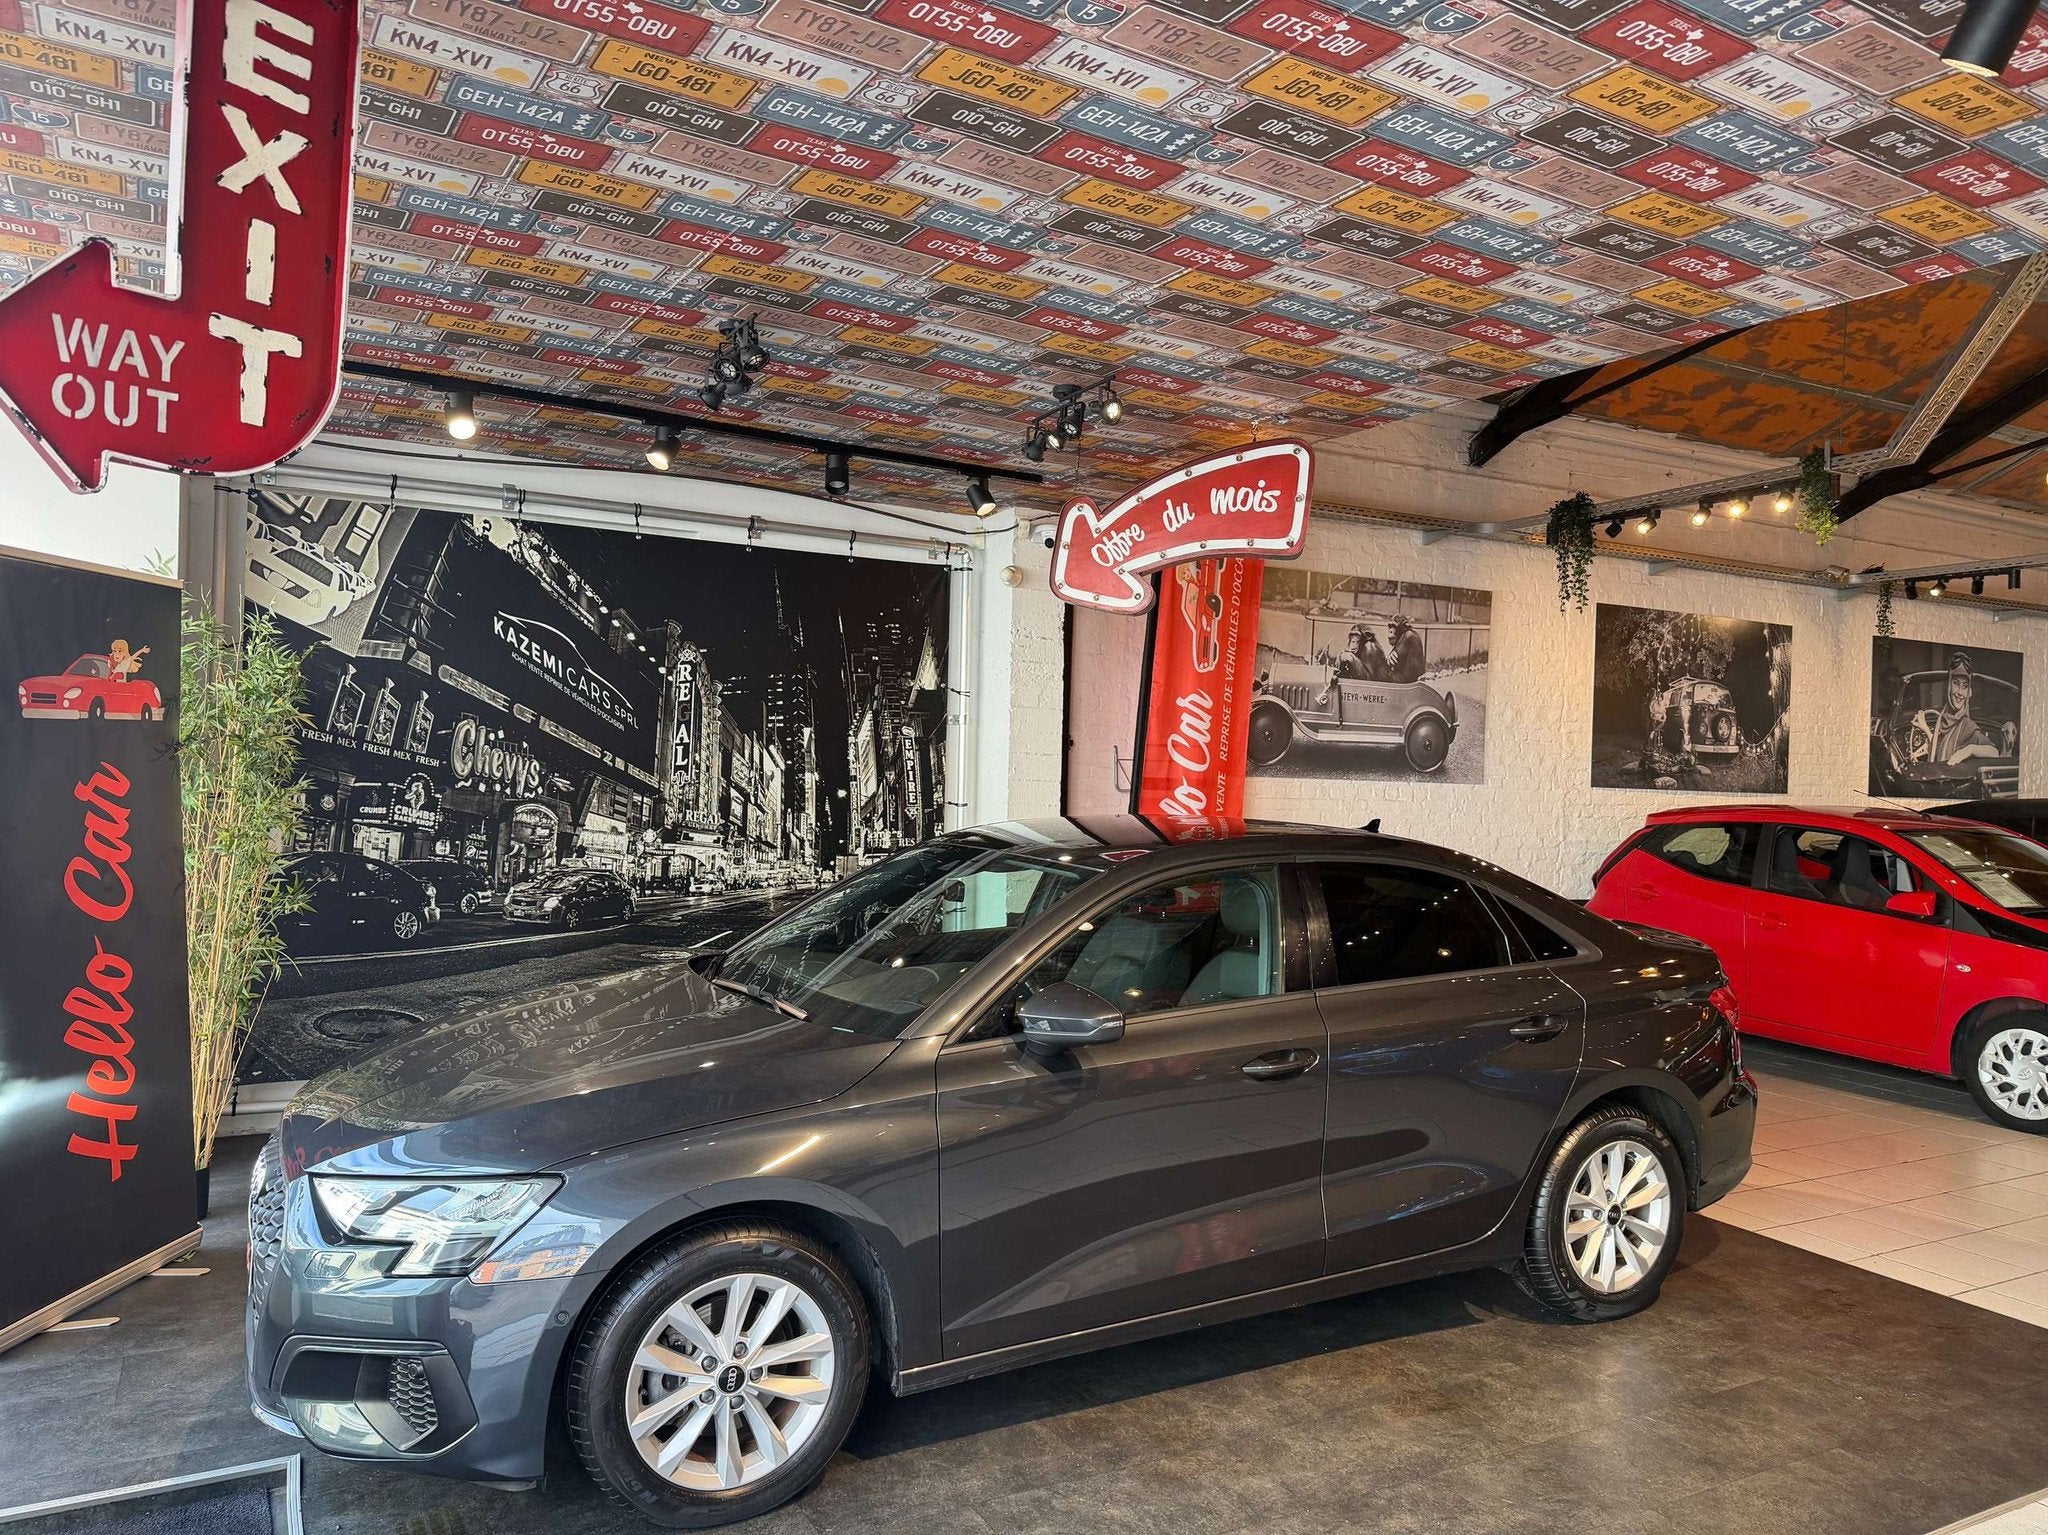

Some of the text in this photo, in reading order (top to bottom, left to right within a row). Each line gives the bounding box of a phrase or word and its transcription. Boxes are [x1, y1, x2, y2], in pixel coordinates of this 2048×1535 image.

[1430, 12, 1463, 29] 15
[1788, 19, 1824, 36] 15
[455, 85, 566, 124] GEH-142A
[873, 89, 900, 103] 66
[1187, 100, 1215, 113] 66
[30, 112, 50, 124] 15
[764, 94, 870, 133] GEH-142A
[1073, 104, 1173, 143] GEH-142A
[1500, 109, 1530, 122] 66
[1817, 113, 1850, 126] 66
[910, 138, 934, 150] 15
[1381, 114, 1475, 152] GEH-142A
[1690, 120, 1781, 156] GEH-142A
[1203, 148, 1228, 159] 15
[1494, 156, 1521, 167] 15
[1790, 159, 1820, 170] 15
[208, 0, 314, 427] EXIT
[407, 193, 501, 221] GEH-142A
[667, 200, 758, 229] GEH-142A
[927, 209, 1014, 238] GEH-142A
[1187, 218, 1269, 245] GEH-142A
[1445, 225, 1524, 251] GEH-142A
[1708, 227, 1786, 253] GEH-142A
[1493, 304, 1561, 323] GEH-142A
[52, 312, 185, 383] WAY
[51, 372, 179, 434] OUT
[1091, 479, 1281, 567] Offre du mois
[1231, 557, 1245, 607] D'OCCA
[1223, 608, 1241, 682] VÉHICULES
[527, 660, 544, 679] VENTE
[563, 686, 572, 696] DE
[1223, 683, 1233, 704] DE
[614, 704, 639, 730] SPRL
[675, 664, 693, 766] REGAL
[1167, 688, 1213, 772] Car
[1219, 704, 1233, 762] REPRISE
[302, 728, 440, 768] FRESH MEX FRESH MEX FRESH
[452, 718, 540, 799] Chevys
[904, 739, 917, 804] EMPIRE
[1215, 771, 1227, 812] VENTE
[359, 806, 387, 814] CRUMBS
[394, 804, 436, 821] CRUMBS
[415, 819, 435, 827] SHOP
[63, 761, 139, 1182] Hello Car
